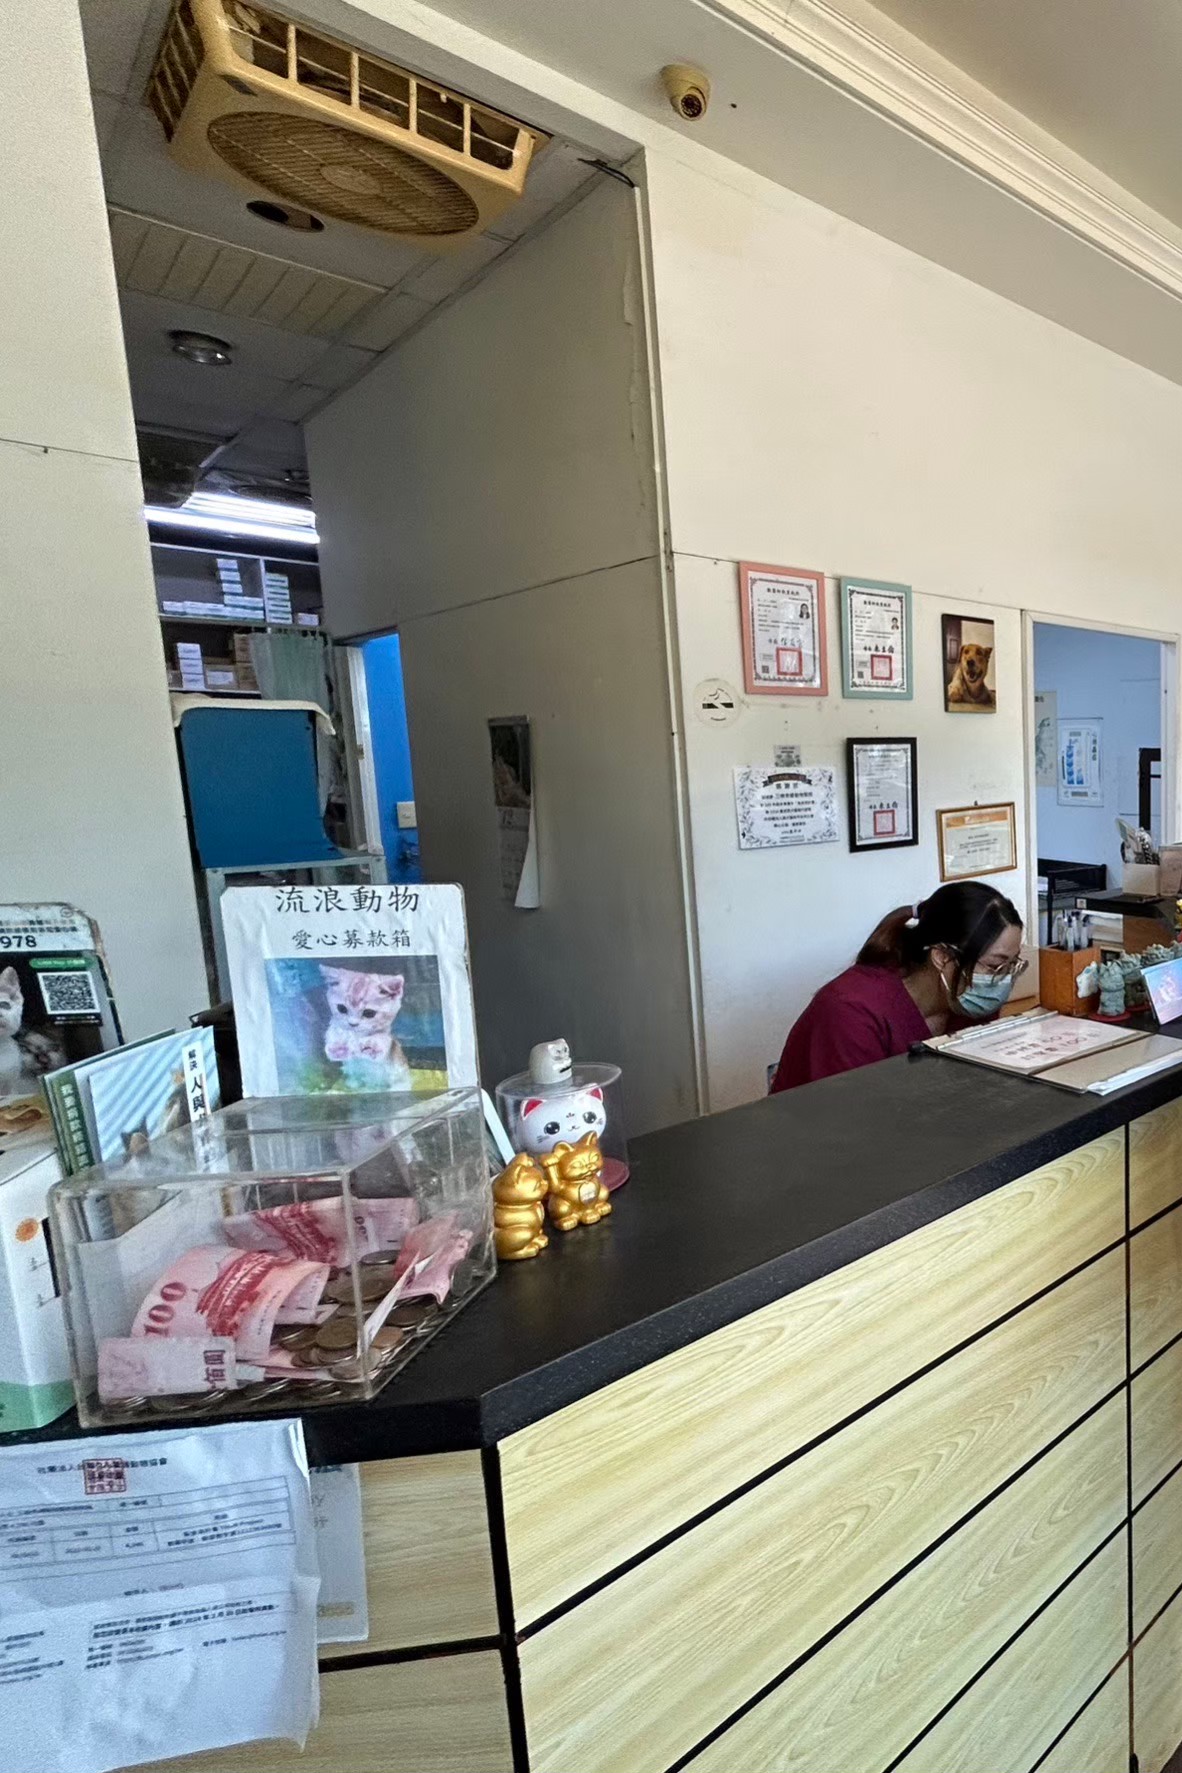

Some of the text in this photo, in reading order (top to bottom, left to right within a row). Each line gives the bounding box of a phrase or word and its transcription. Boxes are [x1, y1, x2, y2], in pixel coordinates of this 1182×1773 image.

[275, 886, 420, 914] 流浪動物
[0, 935, 37, 948] 978
[292, 929, 412, 951] 愛心募款箱
[144, 1281, 187, 1337] 100
